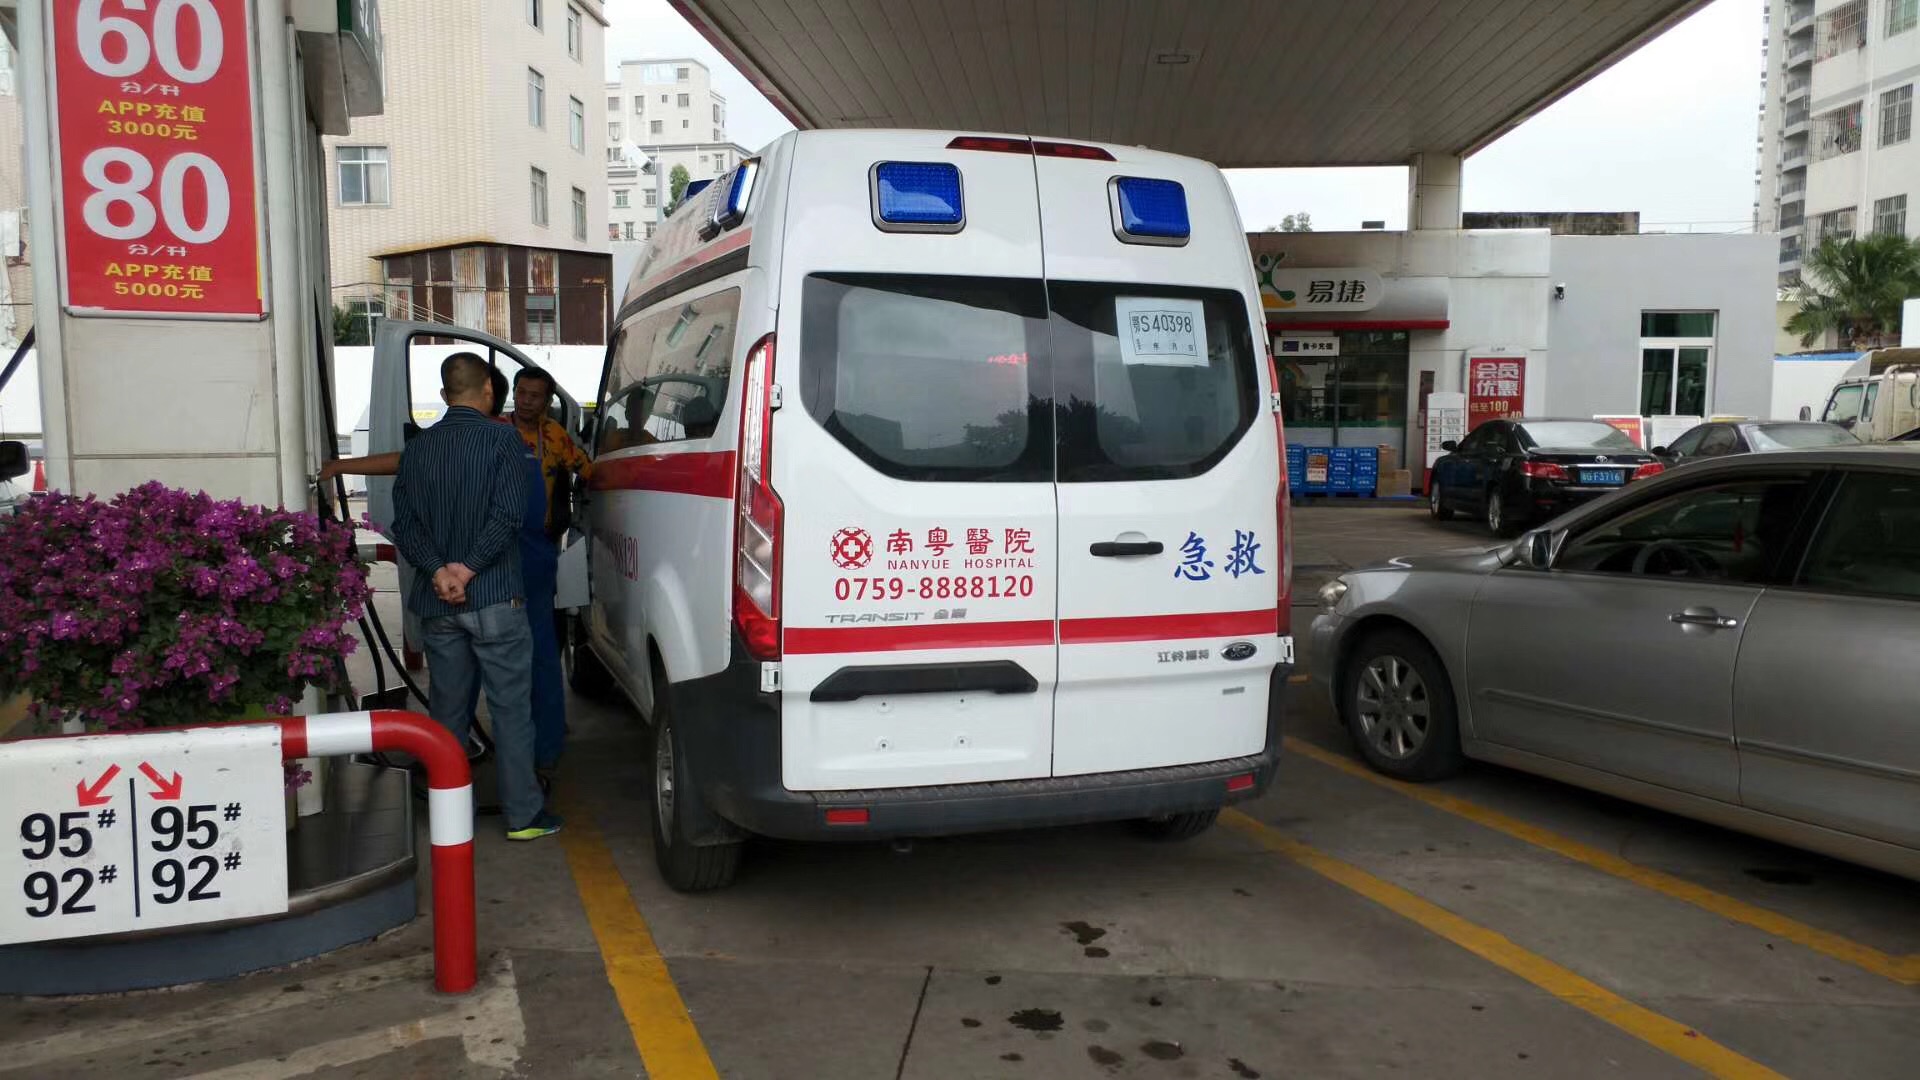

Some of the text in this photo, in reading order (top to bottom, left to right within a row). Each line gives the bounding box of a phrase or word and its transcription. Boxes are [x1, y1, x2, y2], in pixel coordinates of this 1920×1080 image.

[77, 0, 223, 83] 60
[120, 81, 180, 97] 分/升
[98, 100, 206, 123] APP充值
[107, 121, 198, 140] 3000元
[82, 147, 230, 244] 80
[128, 244, 188, 257] 分/升
[105, 262, 213, 282] APP充值
[115, 281, 204, 299] 5000元
[1307, 280, 1366, 303] 易捷
[1476, 362, 1519, 379] 会员
[1476, 380, 1519, 396] 优惠
[886, 526, 1035, 557] 南粤醫院
[887, 558, 1034, 570] NANYUE HOSPITAL
[1174, 529, 1266, 581] 急救
[835, 575, 1034, 601] 0759-8888120
[825, 612, 925, 624] TRANSIT
[20, 808, 116, 860] 95#
[150, 802, 241, 852] 95#
[151, 851, 241, 904] 92#
[23, 864, 117, 918] 92#
